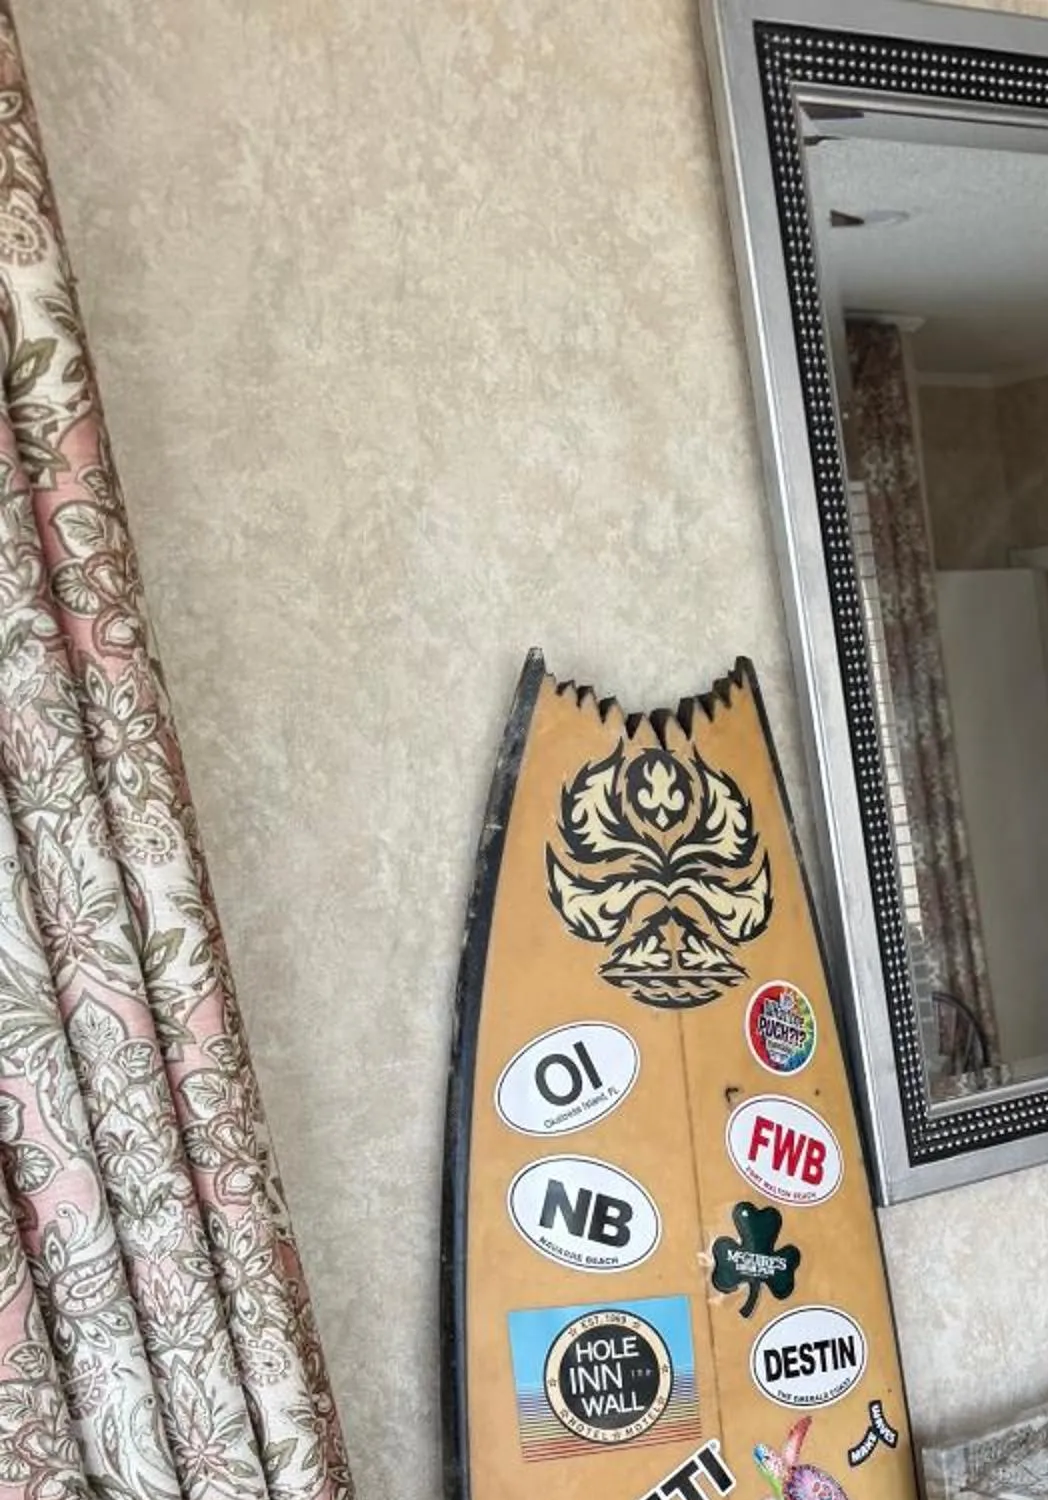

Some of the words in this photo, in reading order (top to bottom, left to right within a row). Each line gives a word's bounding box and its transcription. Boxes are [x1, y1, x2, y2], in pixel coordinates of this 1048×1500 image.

[534, 1040, 603, 1107] OI
[748, 1115, 827, 1185] FWB
[539, 1178, 633, 1248] NB
[539, 1236, 583, 1263] NAVARRE
[585, 1255, 619, 1265] BEACH
[575, 1336, 640, 1363] HOLE
[763, 1335, 857, 1382] DESTIN
[569, 1362, 623, 1395] INN
[581, 1391, 645, 1418] WALL
